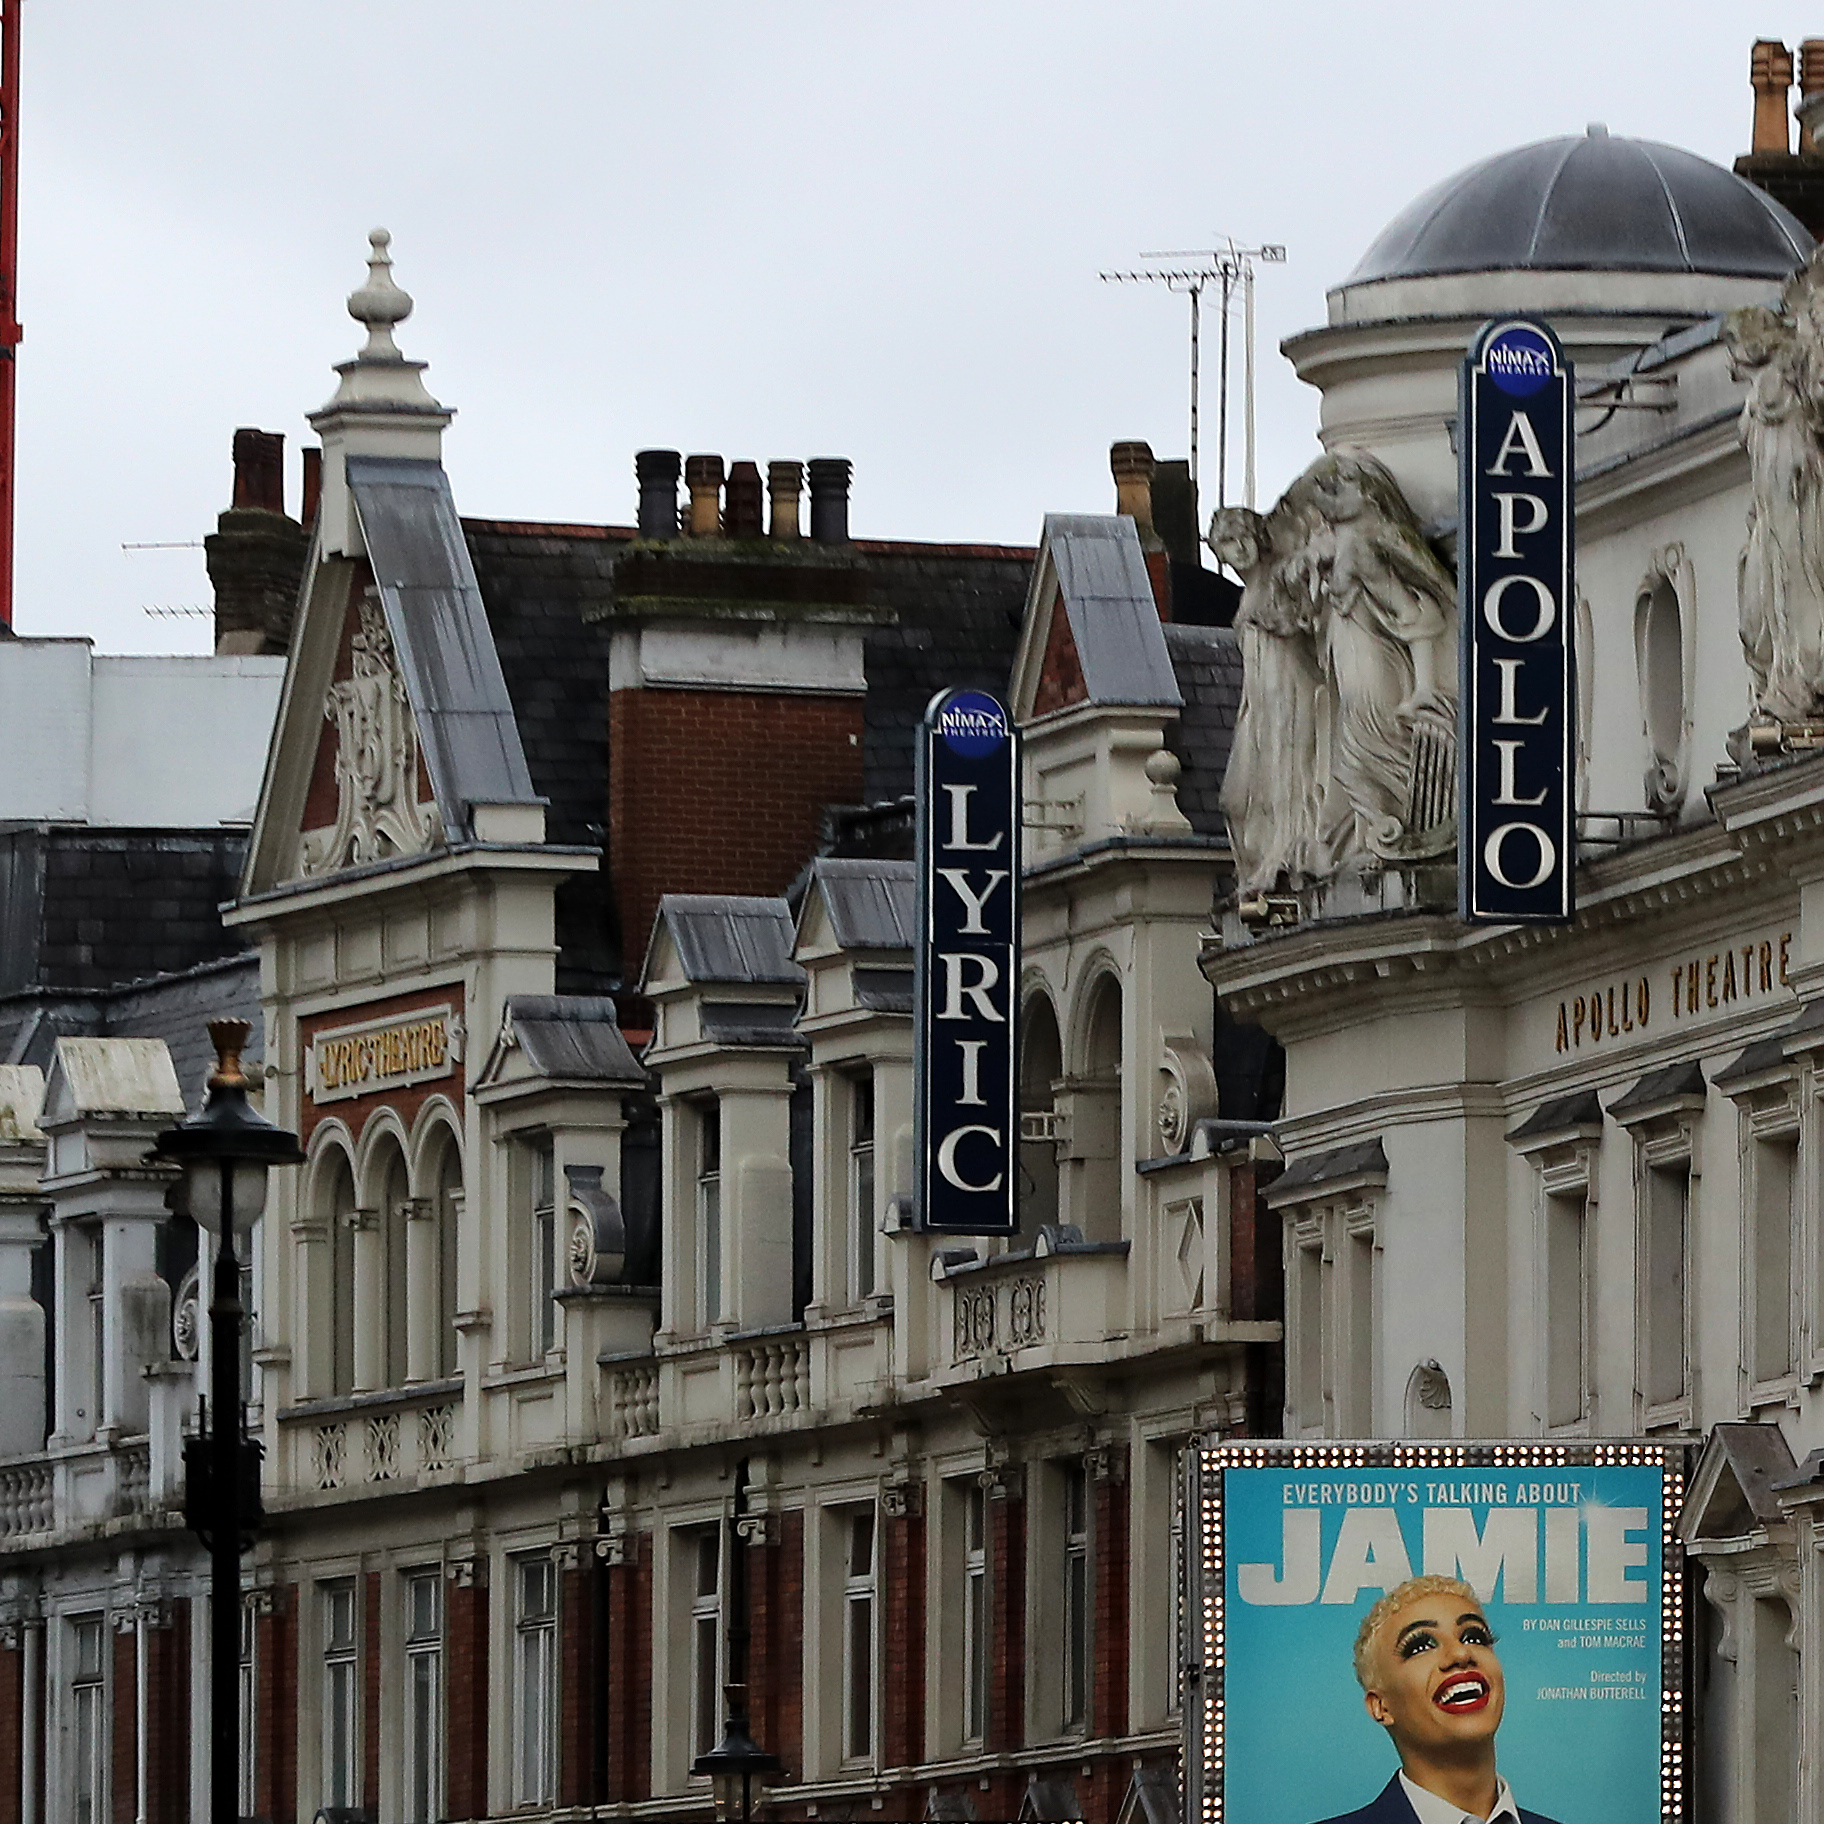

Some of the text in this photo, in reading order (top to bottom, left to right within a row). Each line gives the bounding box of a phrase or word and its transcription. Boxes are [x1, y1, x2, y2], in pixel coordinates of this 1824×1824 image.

[1482, 409, 1556, 890] APOLLO
[935, 784, 1006, 1193] LYRIC
[1555, 932, 1793, 1054] APOLLO THEATRE
[323, 1020, 445, 1089] LYRIC THEATRE
[1283, 1482, 1581, 1504] EVERYBODY'S TALKING ABOUT
[1237, 1507, 1648, 1606] JAMIE
[1523, 1618, 1646, 1631] BY DAN GILLESPIE SELLS
[1557, 1636, 1646, 1649] and TOM MACRAE
[1536, 1687, 1646, 1700] JONATHAN BUTTERELL
[1591, 1670, 1647, 1687] Directed by
